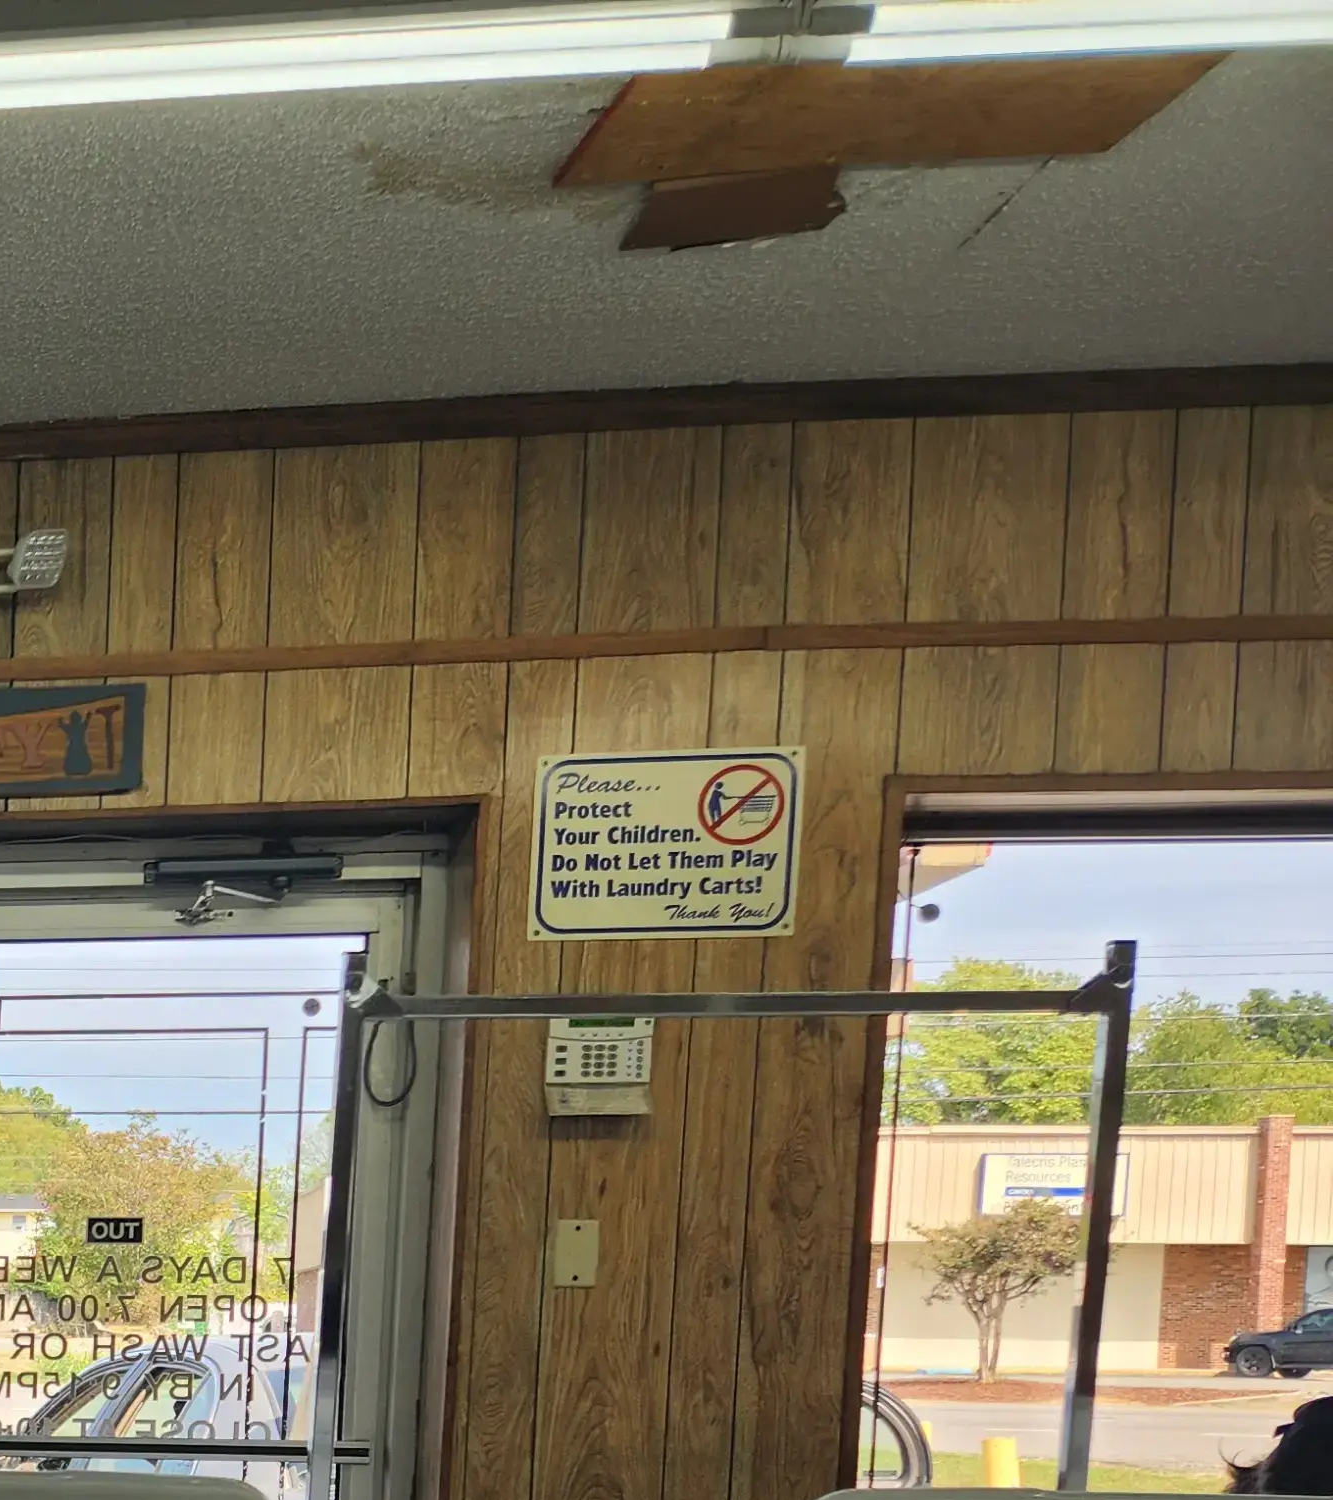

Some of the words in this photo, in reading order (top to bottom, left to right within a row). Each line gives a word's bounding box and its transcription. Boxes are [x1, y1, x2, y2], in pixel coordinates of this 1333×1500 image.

[555, 773, 661, 795] Please...
[554, 801, 632, 820] Protect
[554, 827, 600, 846] Your
[607, 825, 701, 844] Children.
[551, 855, 577, 872] Do
[585, 854, 621, 871] Not
[628, 853, 661, 870] Let
[667, 851, 724, 869] Them
[731, 850, 778, 872] Play
[551, 879, 600, 898] With
[607, 878, 691, 900] Laundry
[699, 876, 762, 895] Carts!
[663, 904, 721, 921] Thank
[728, 902, 775, 923] You!
[1005, 1171, 1071, 1183] Resources
[90, 1222, 140, 1241] OUT
